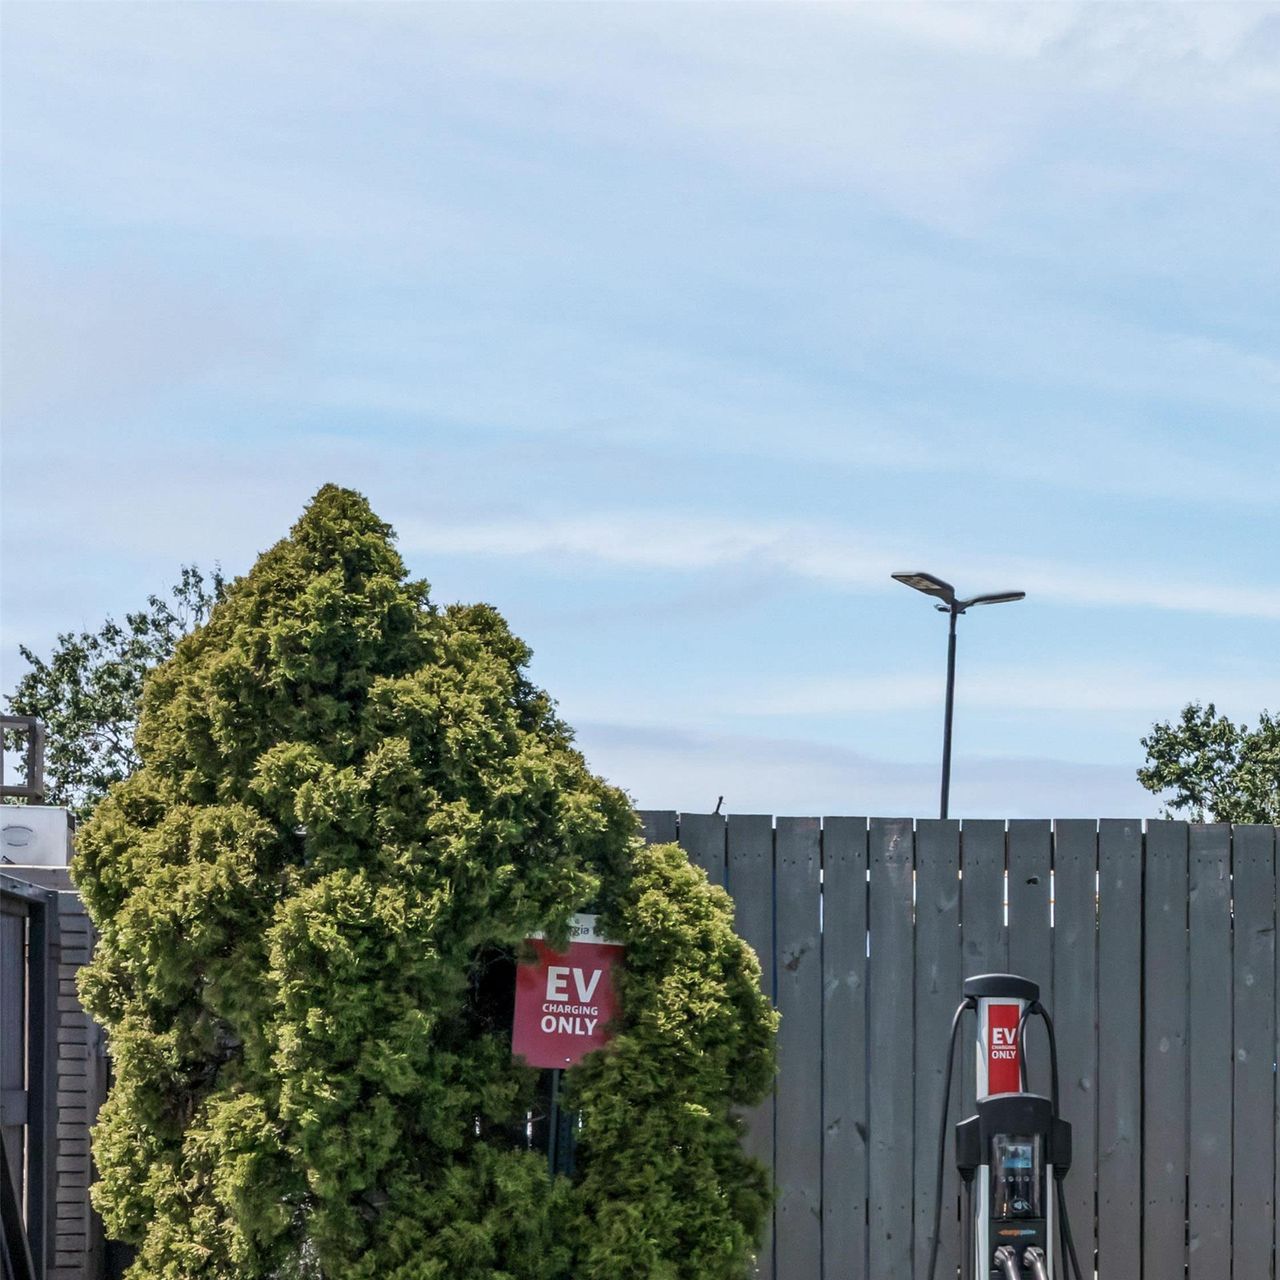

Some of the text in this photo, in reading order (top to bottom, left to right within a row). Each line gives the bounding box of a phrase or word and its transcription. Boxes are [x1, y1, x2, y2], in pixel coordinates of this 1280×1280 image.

[546, 966, 602, 1003] EV
[542, 1003, 598, 1016] CHARGING
[541, 1015, 598, 1036] ONLY
[992, 1027, 1016, 1045] EV
[991, 1050, 1016, 1059] ONLY
